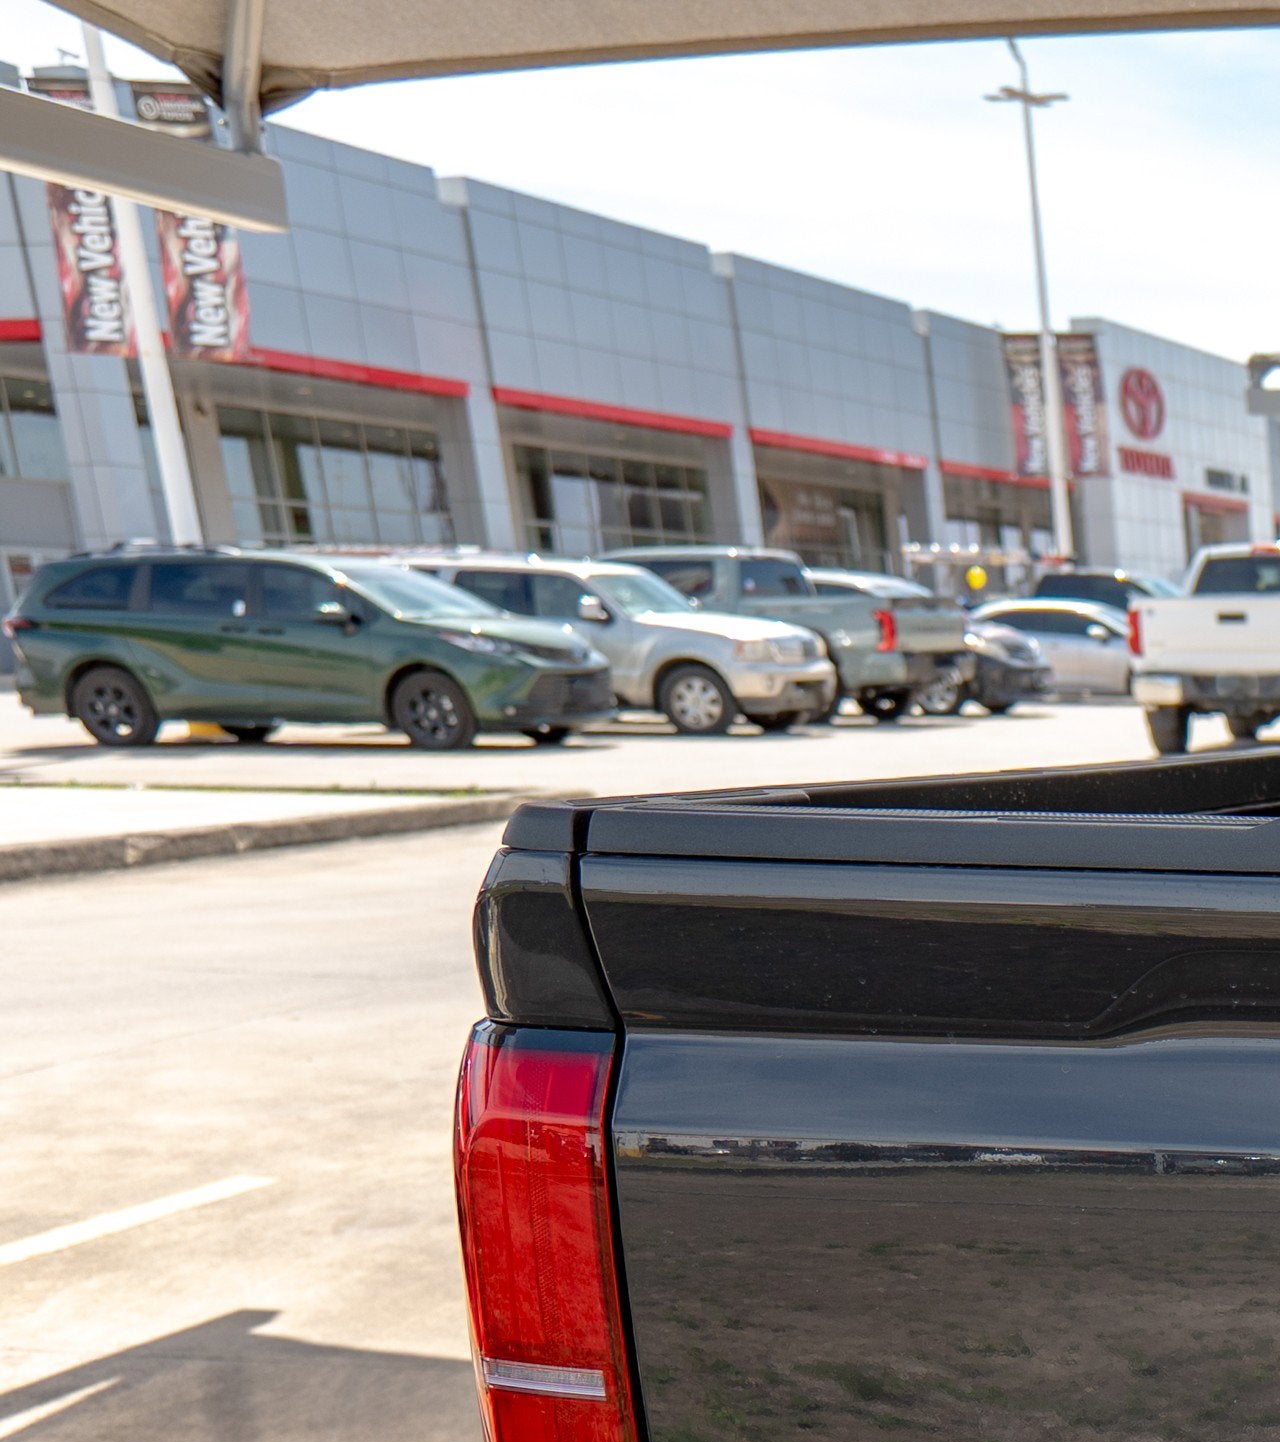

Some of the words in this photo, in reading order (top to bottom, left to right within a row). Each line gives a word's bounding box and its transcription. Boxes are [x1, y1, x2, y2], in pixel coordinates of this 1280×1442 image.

[174, 211, 221, 276] Veh
[85, 275, 124, 342] New
[190, 280, 229, 347] New
